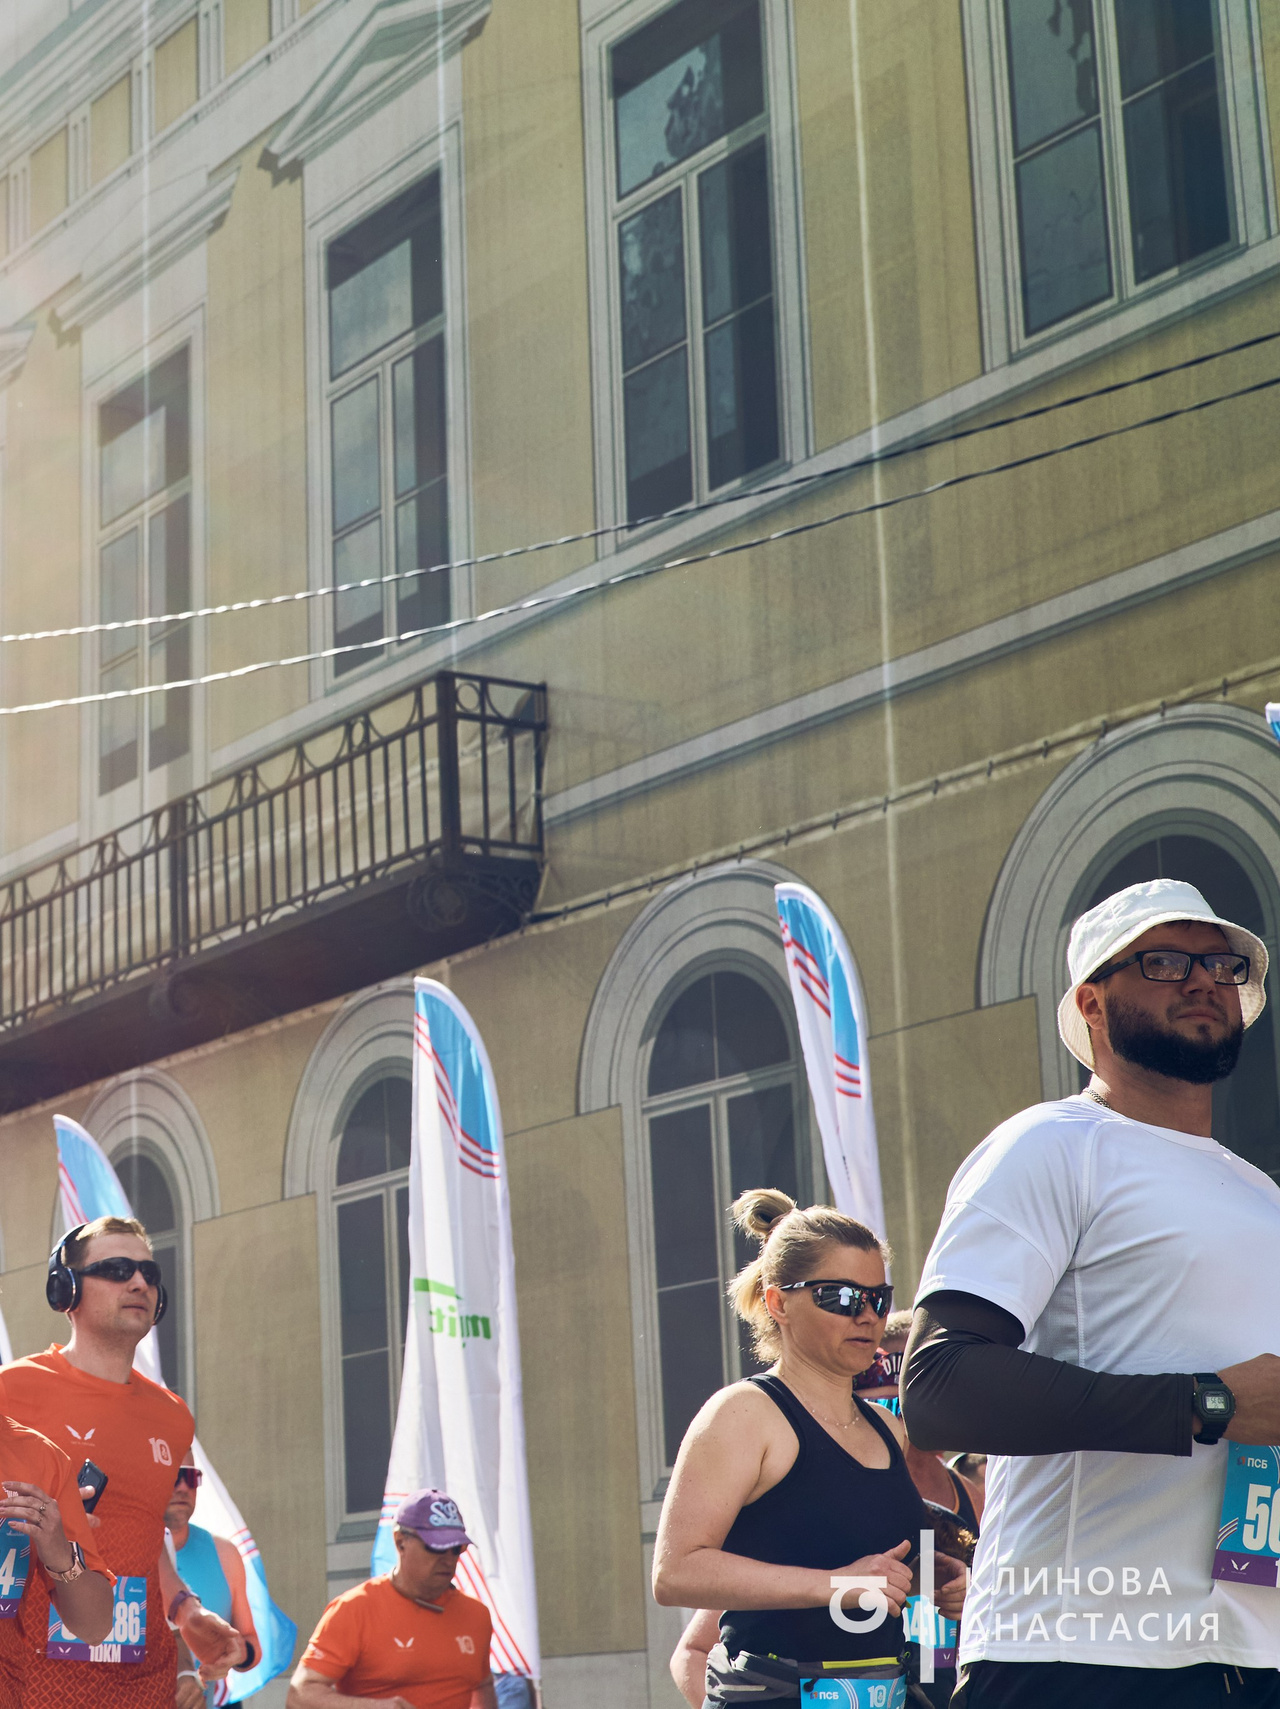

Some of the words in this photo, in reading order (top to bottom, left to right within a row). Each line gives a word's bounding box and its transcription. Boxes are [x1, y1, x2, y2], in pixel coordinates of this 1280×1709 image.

[148, 1437, 173, 1467] 10
[1247, 1457, 1268, 1469] ПСБ
[819, 1691, 839, 1700] ПСБ
[867, 1685, 887, 1708] 10
